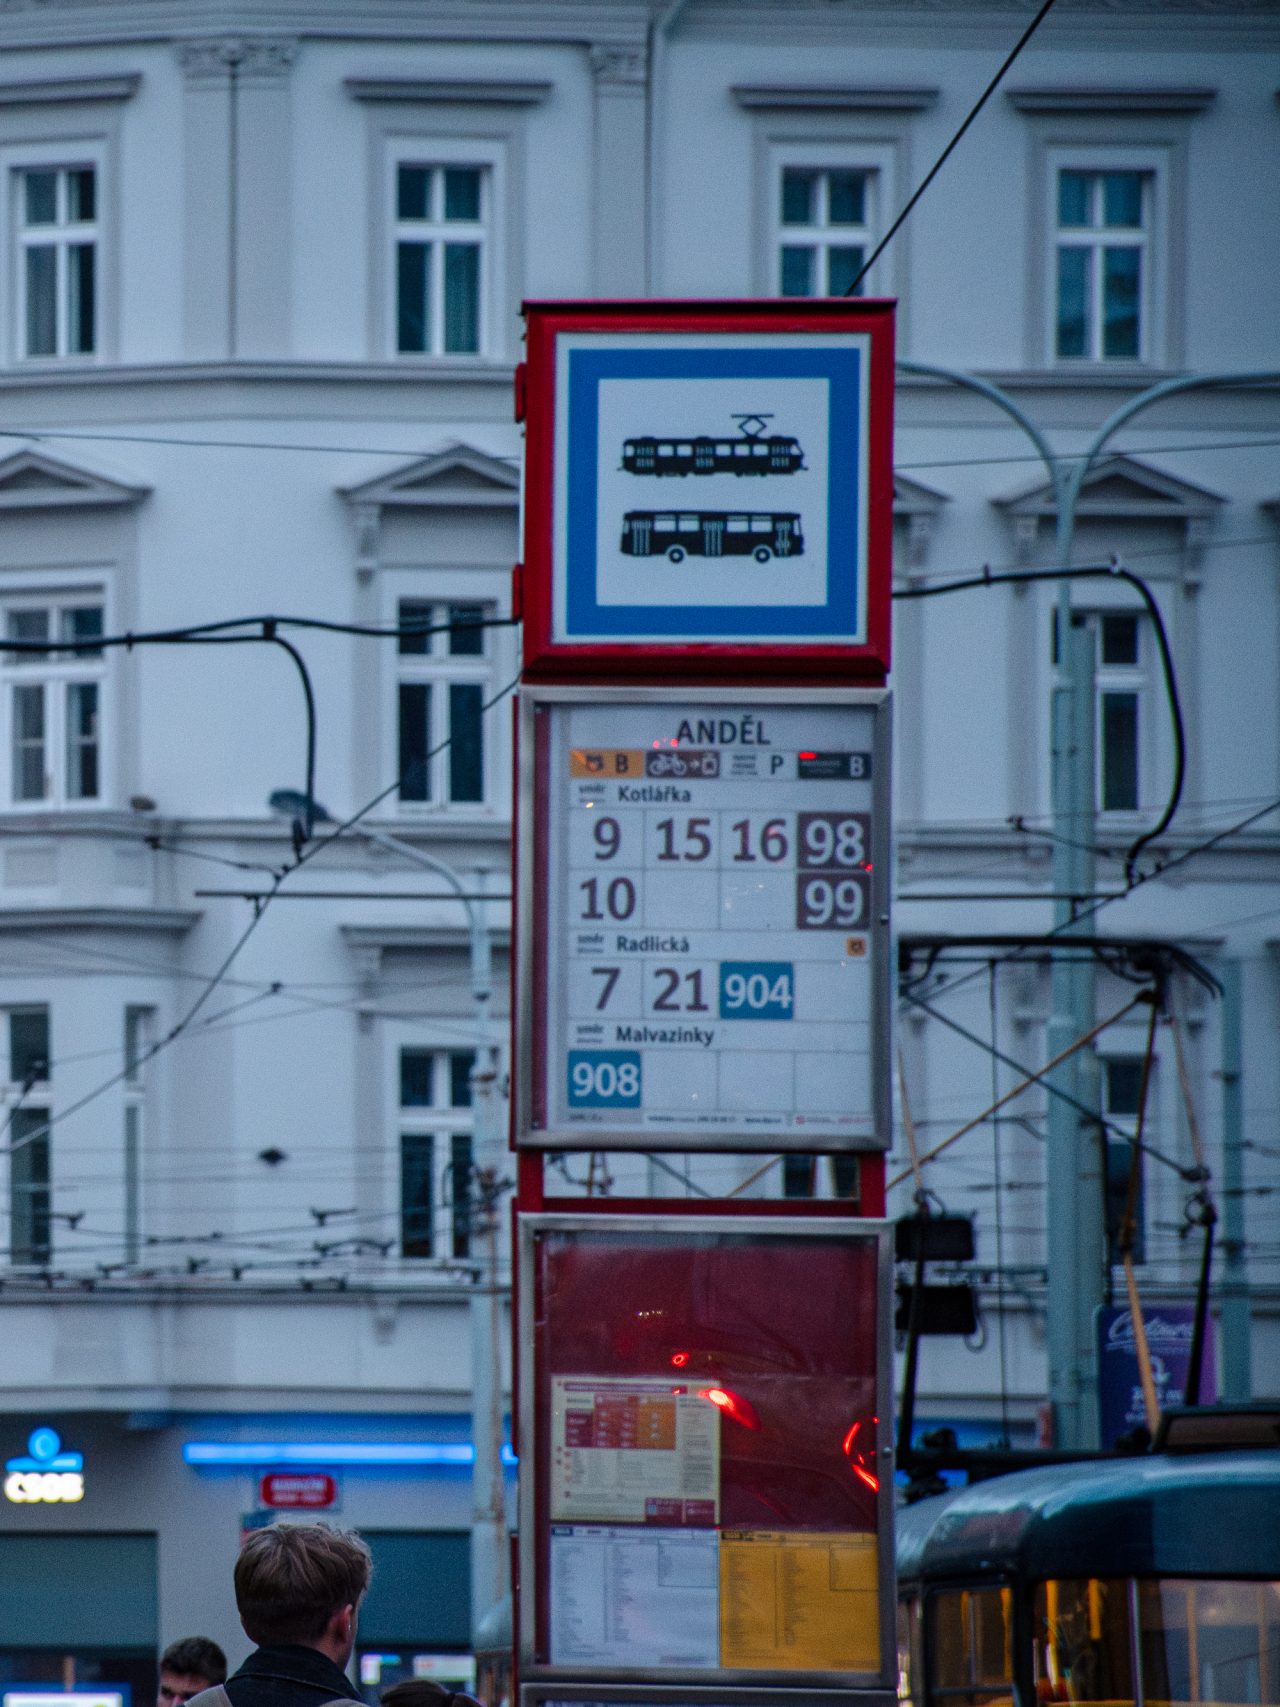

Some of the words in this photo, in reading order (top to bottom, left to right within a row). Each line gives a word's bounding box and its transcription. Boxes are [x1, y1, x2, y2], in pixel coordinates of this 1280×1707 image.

[677, 715, 771, 745] ANDĚL
[614, 754, 629, 774] B
[770, 754, 784, 775] P
[849, 755, 865, 778] B
[618, 785, 692, 802] Kotlářka
[593, 816, 621, 861] 9
[656, 817, 712, 862] 15
[732, 818, 789, 863] 16
[804, 818, 865, 866] 98
[580, 876, 636, 921] 10
[804, 879, 864, 925] 99
[616, 935, 690, 953] Radlická
[591, 967, 621, 1011] 7
[652, 967, 709, 1012] 21
[724, 973, 793, 1009] 904
[616, 1025, 715, 1048] Malvazinky
[571, 1062, 641, 1098] 908
